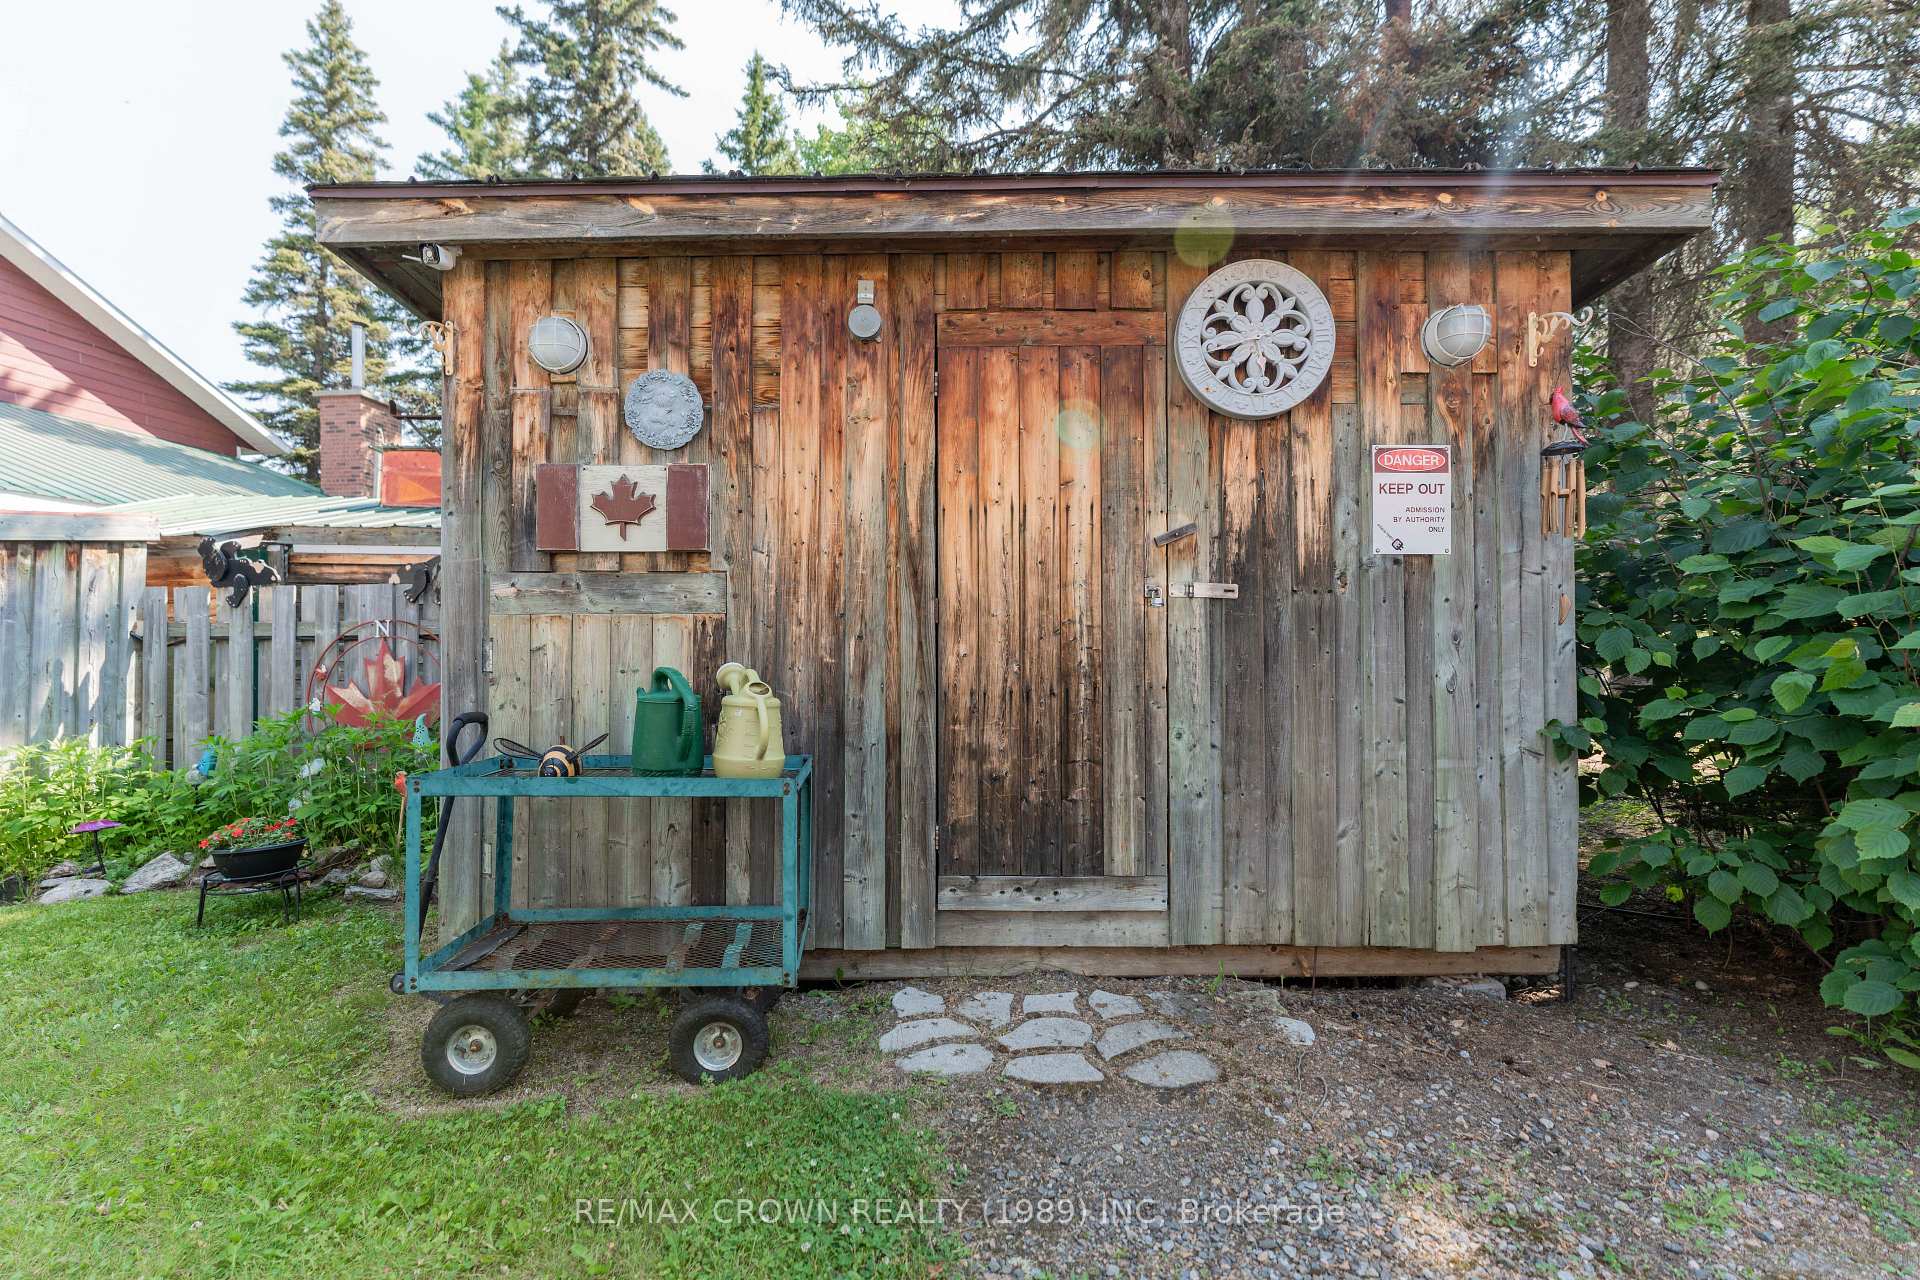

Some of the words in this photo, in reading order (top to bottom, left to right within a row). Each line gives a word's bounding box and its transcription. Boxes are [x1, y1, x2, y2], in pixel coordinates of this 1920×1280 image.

[1384, 455, 1439, 466] DANGER
[1379, 483, 1413, 495] KEEP
[1418, 483, 1445, 495] OUT
[375, 619, 391, 638] N
